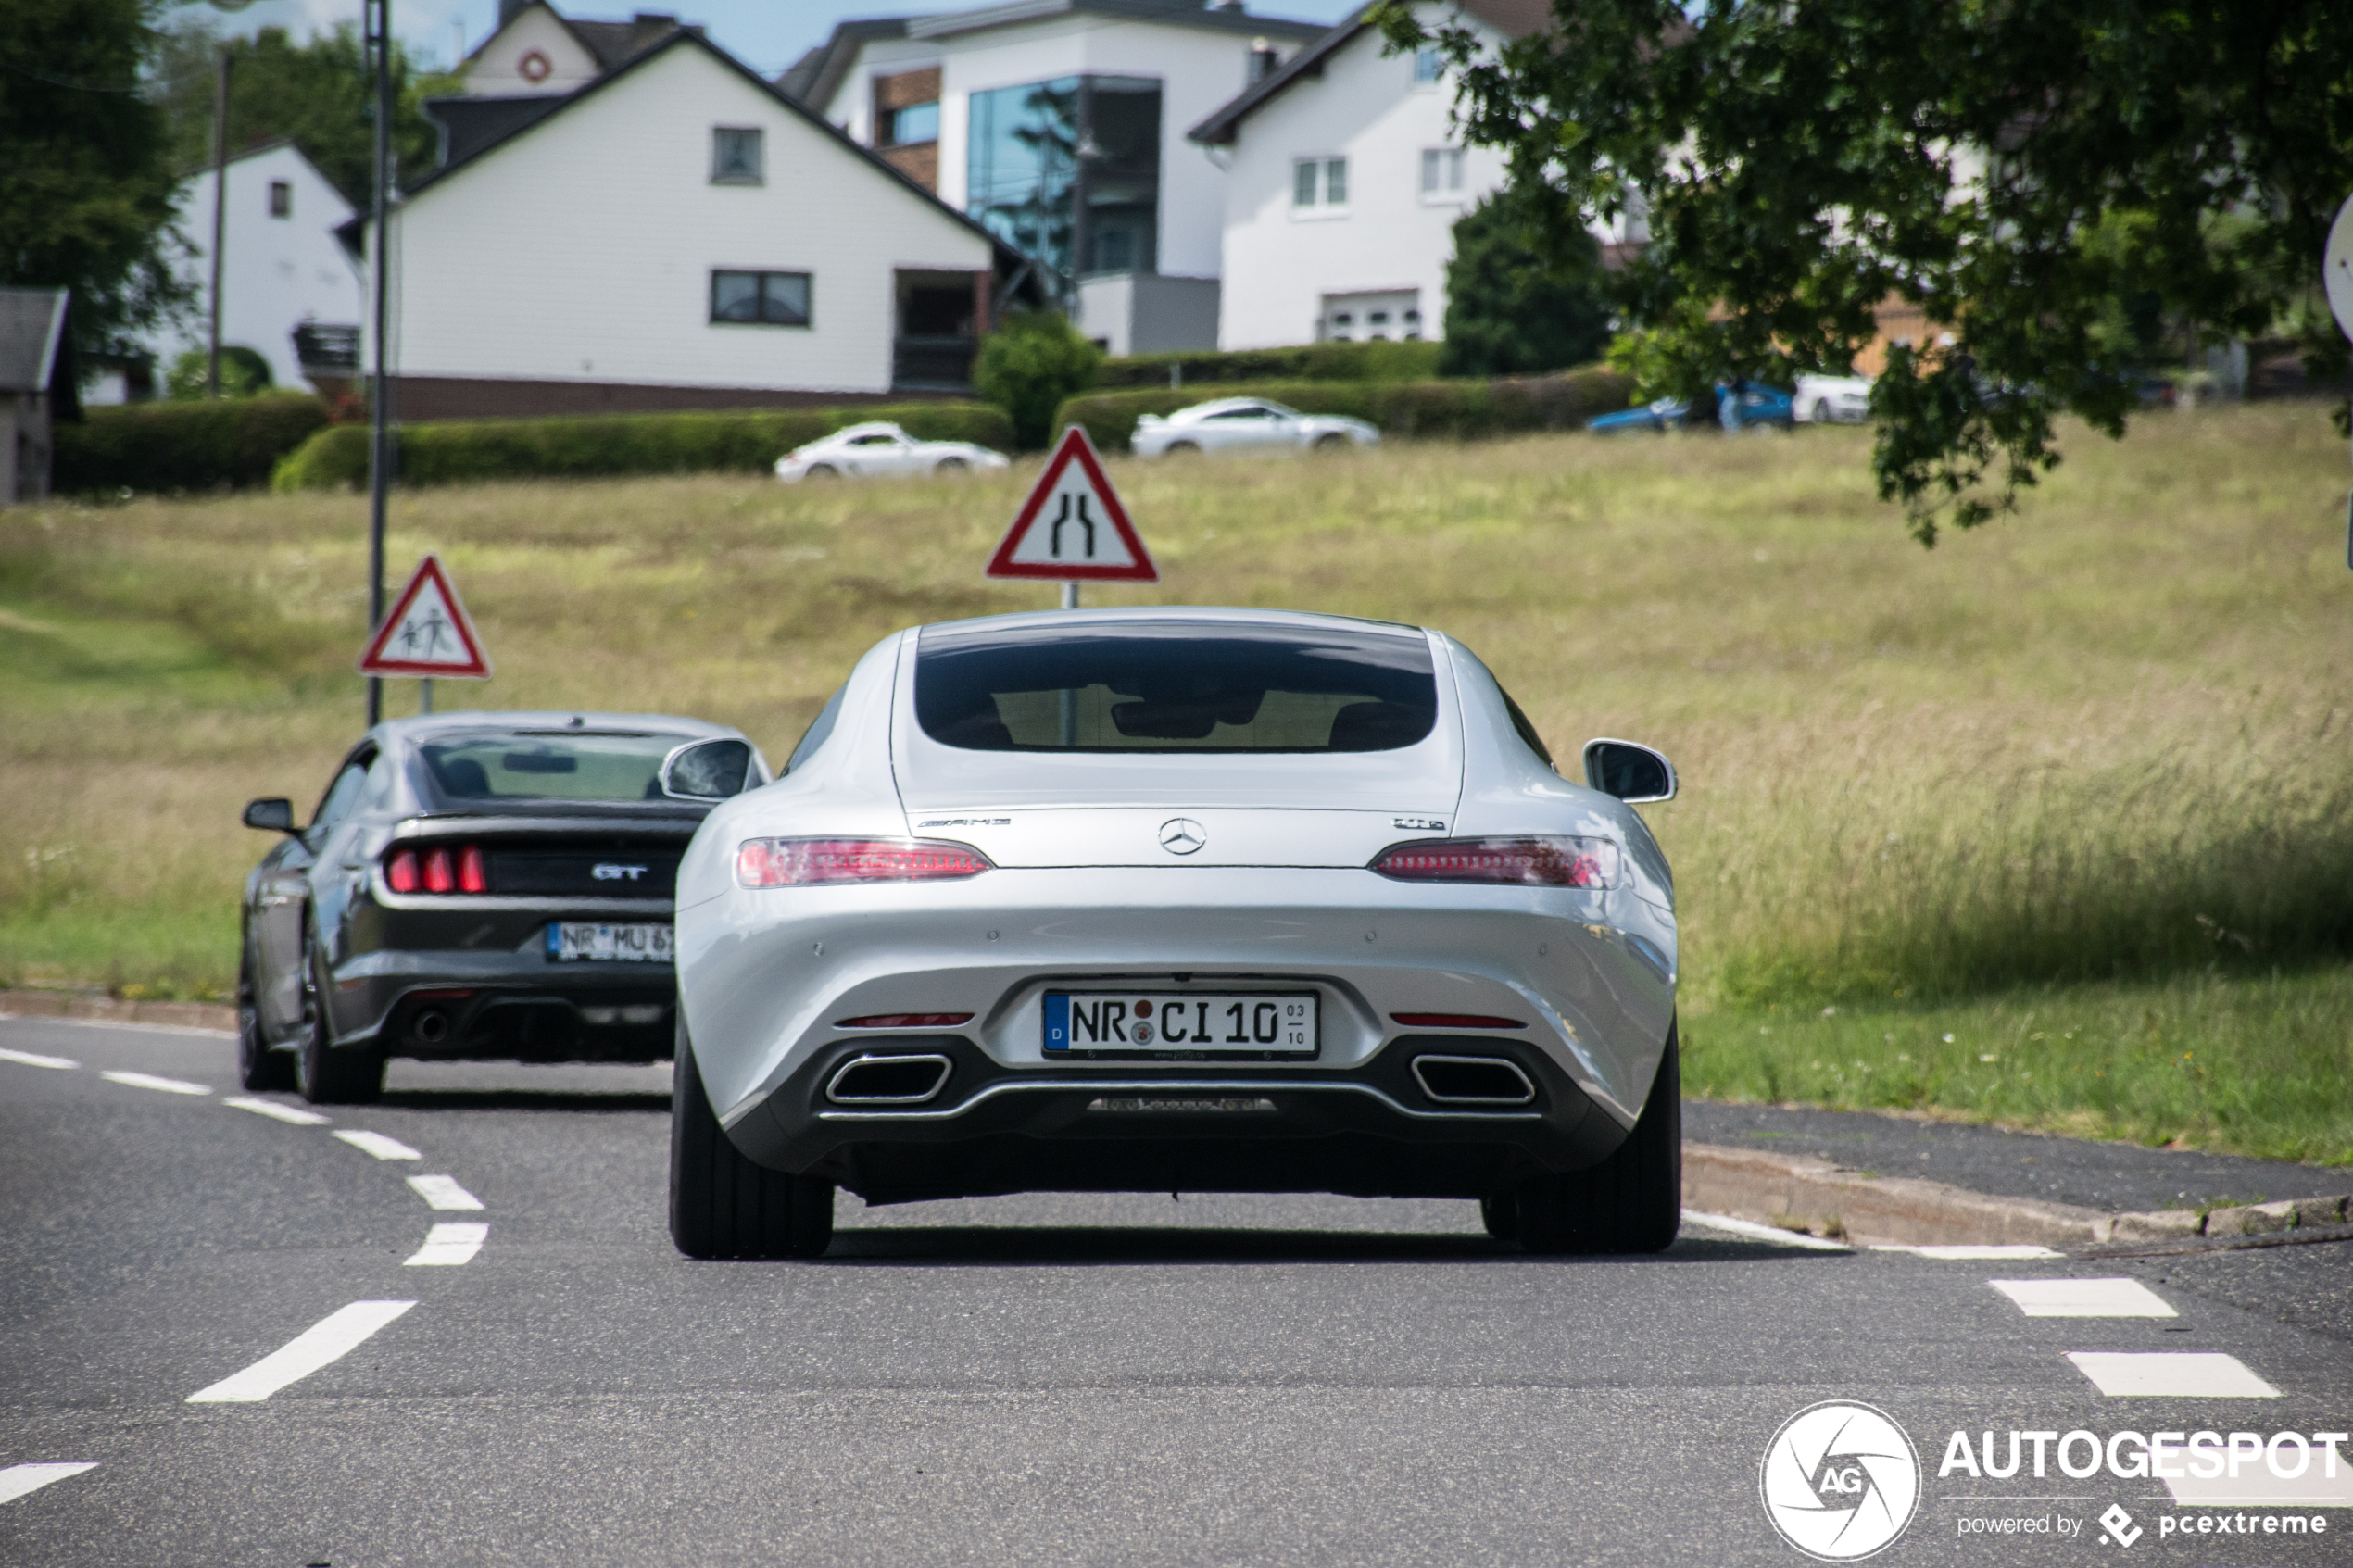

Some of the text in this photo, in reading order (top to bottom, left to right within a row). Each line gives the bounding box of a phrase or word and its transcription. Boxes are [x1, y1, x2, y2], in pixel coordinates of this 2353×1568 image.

[591, 863, 648, 880] GT
[1287, 1004, 1304, 1017] 03
[1072, 1002, 1277, 1043] NR CI 10
[1052, 1028, 1062, 1040] D
[1288, 1032, 1303, 1045] 10
